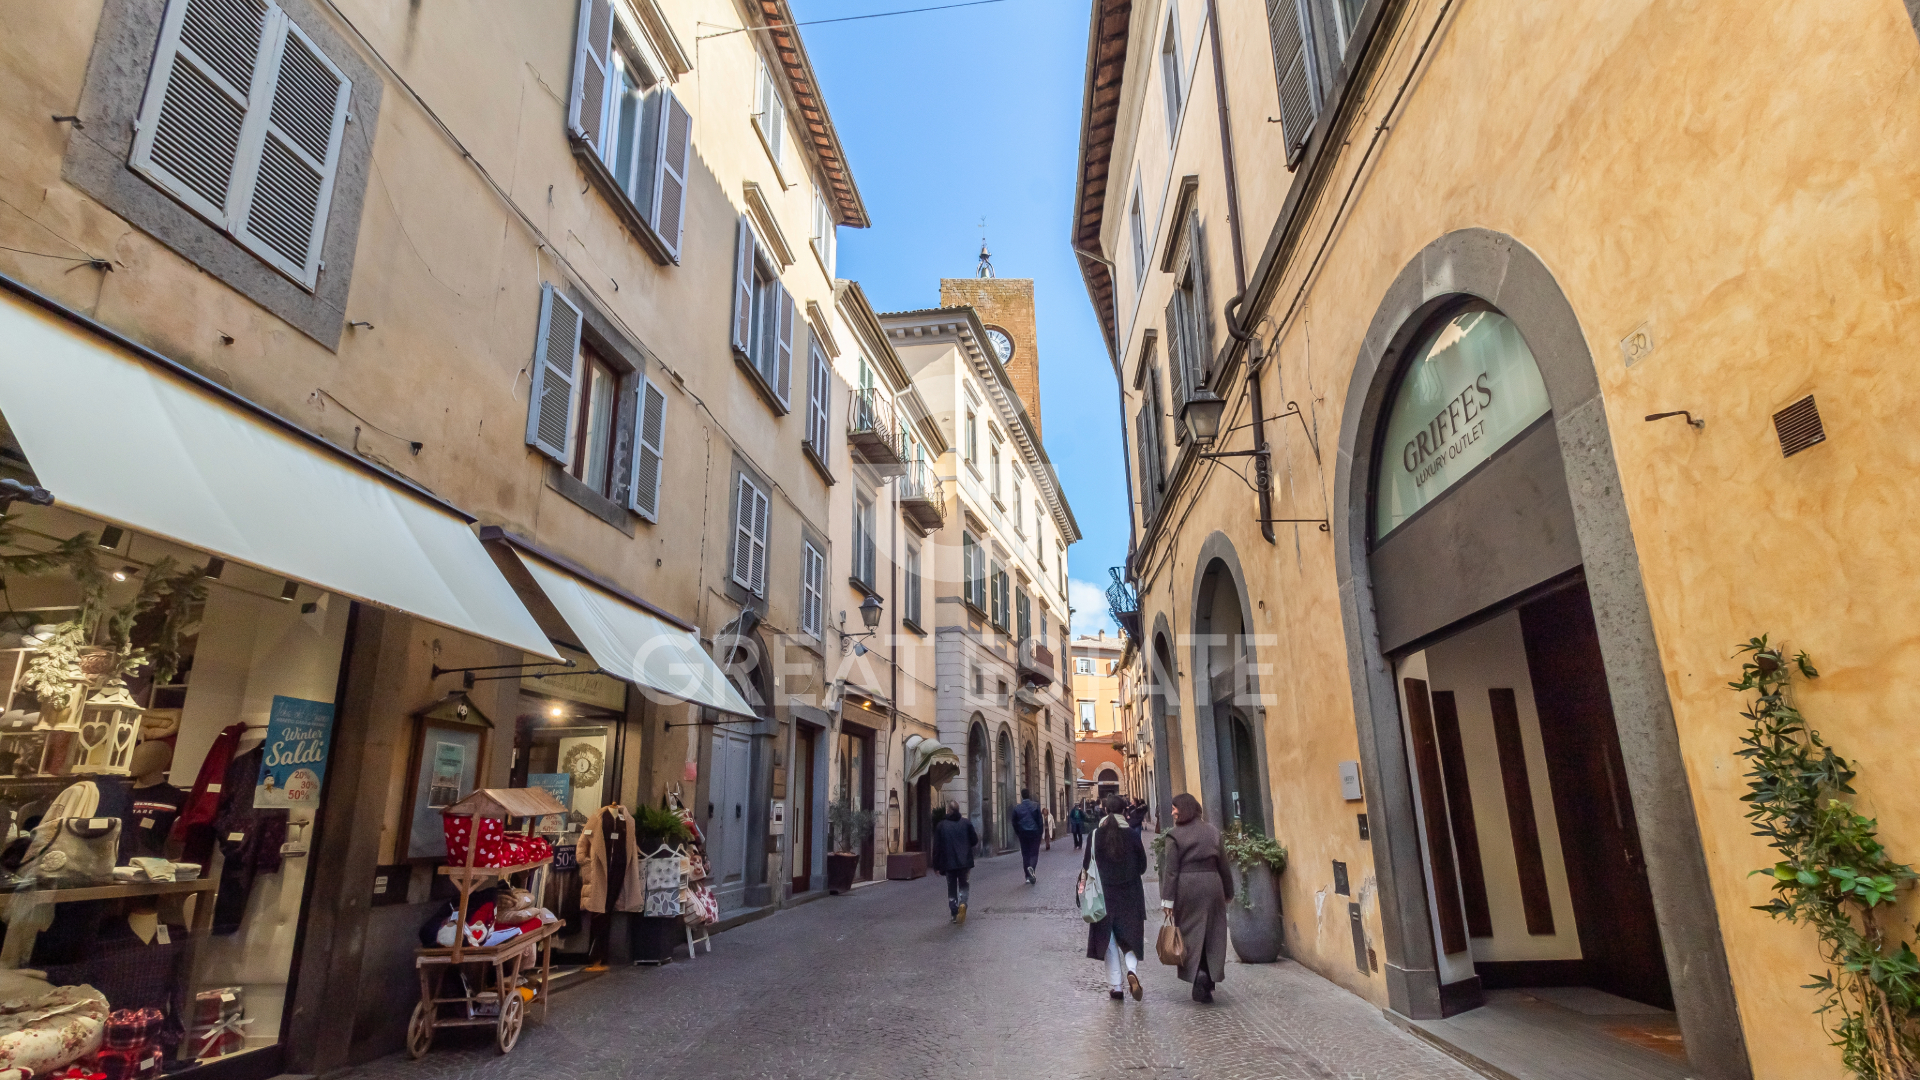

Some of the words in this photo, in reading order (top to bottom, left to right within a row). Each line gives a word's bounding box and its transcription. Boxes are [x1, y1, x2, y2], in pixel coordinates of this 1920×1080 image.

[1629, 332, 1647, 356] 30
[1403, 371, 1492, 473] GRIFFES
[1415, 451, 1447, 488] LUXURY
[1448, 419, 1485, 460] OUTLET
[281, 727, 323, 742] Winter
[265, 740, 325, 767] Saldi
[294, 771, 311, 779] 20%
[288, 789, 310, 800] 50%
[301, 781, 318, 790] 30%
